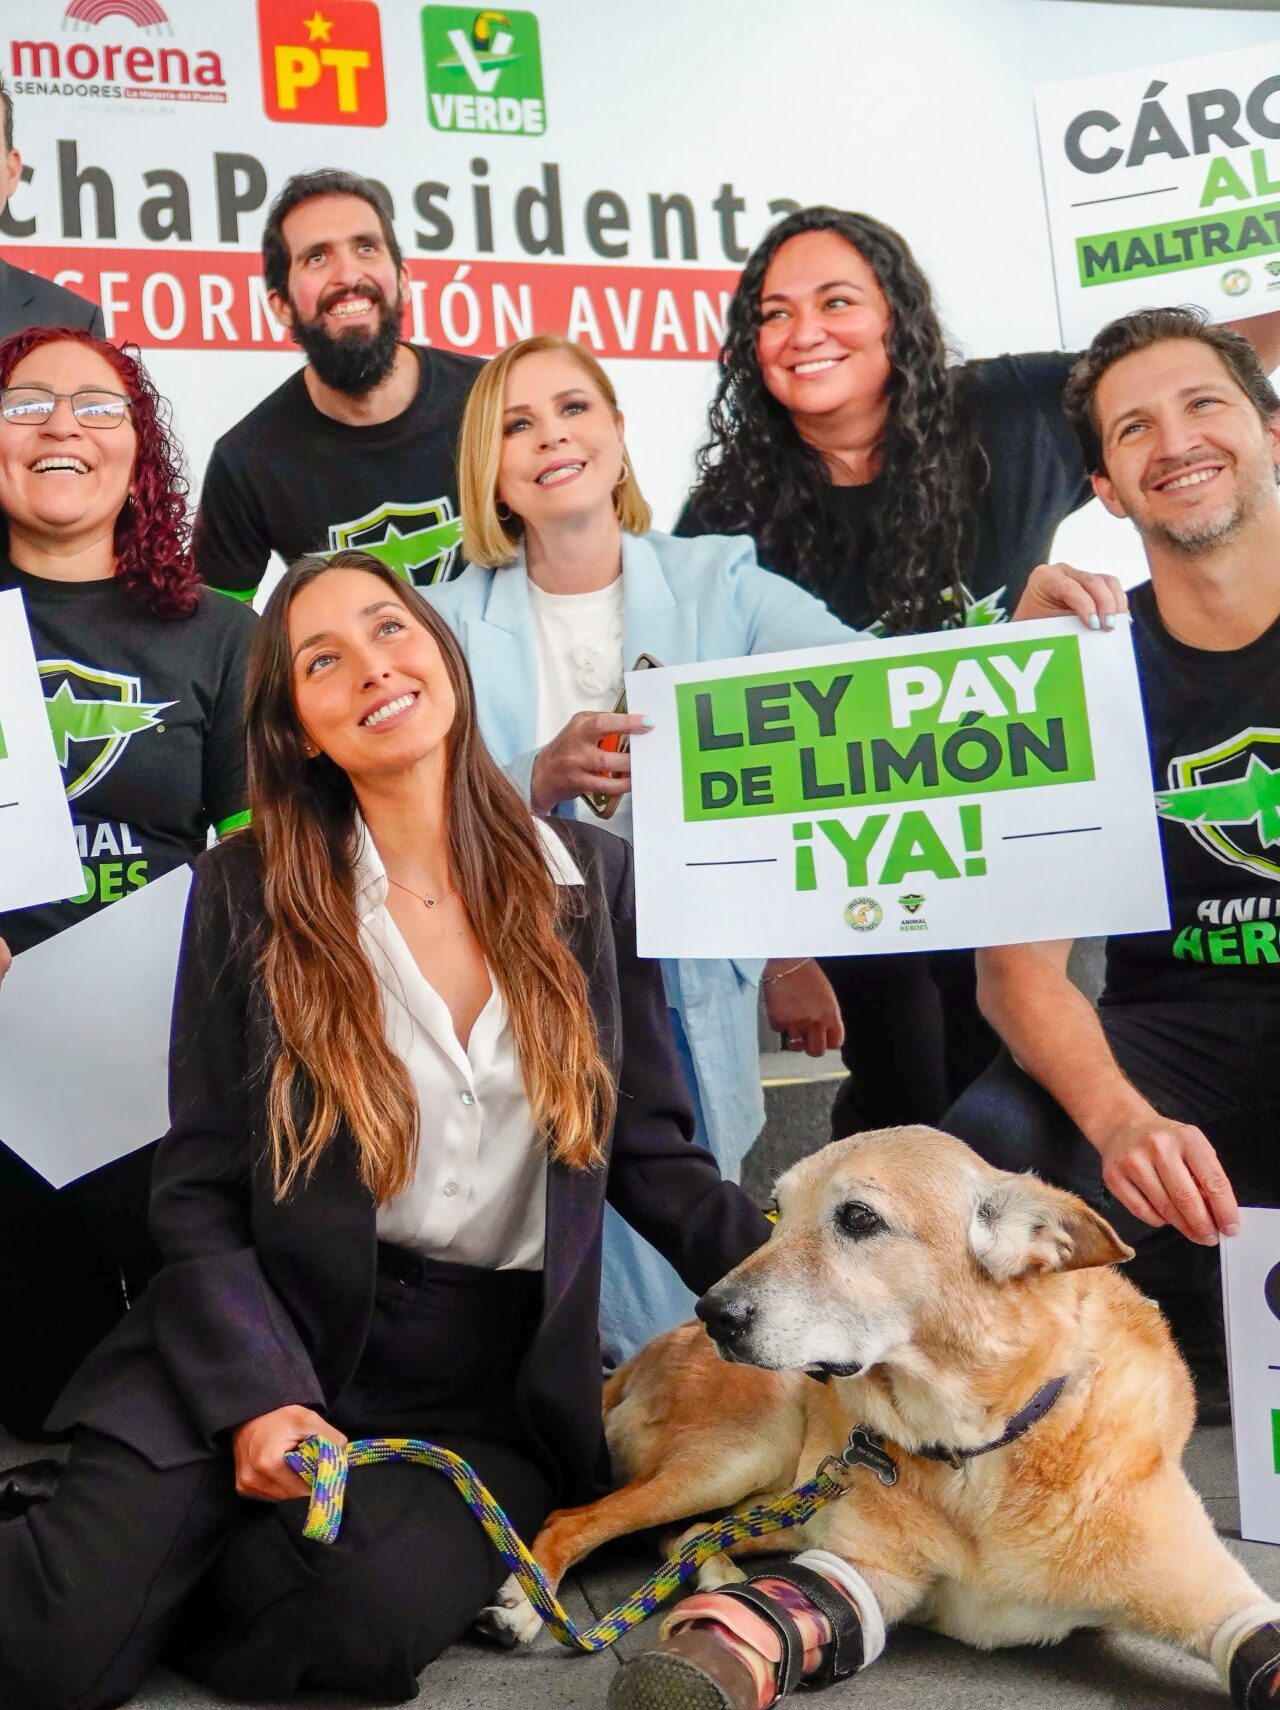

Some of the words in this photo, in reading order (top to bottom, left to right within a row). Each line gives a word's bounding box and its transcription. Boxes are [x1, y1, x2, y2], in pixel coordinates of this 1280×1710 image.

[9, 40, 226, 87] morena
[14, 82, 121, 98] SENADORES
[274, 45, 370, 112] PT
[430, 93, 544, 133] VERDE
[567, 286, 729, 352] AVAN
[694, 674, 854, 752] LEY
[887, 649, 1055, 729] PAY
[699, 765, 775, 810] DE
[799, 710, 1069, 800] LIMÓN
[792, 804, 987, 891] ¡YA!
[1197, 896, 1280, 925] ANI
[1172, 920, 1280, 965] HER
